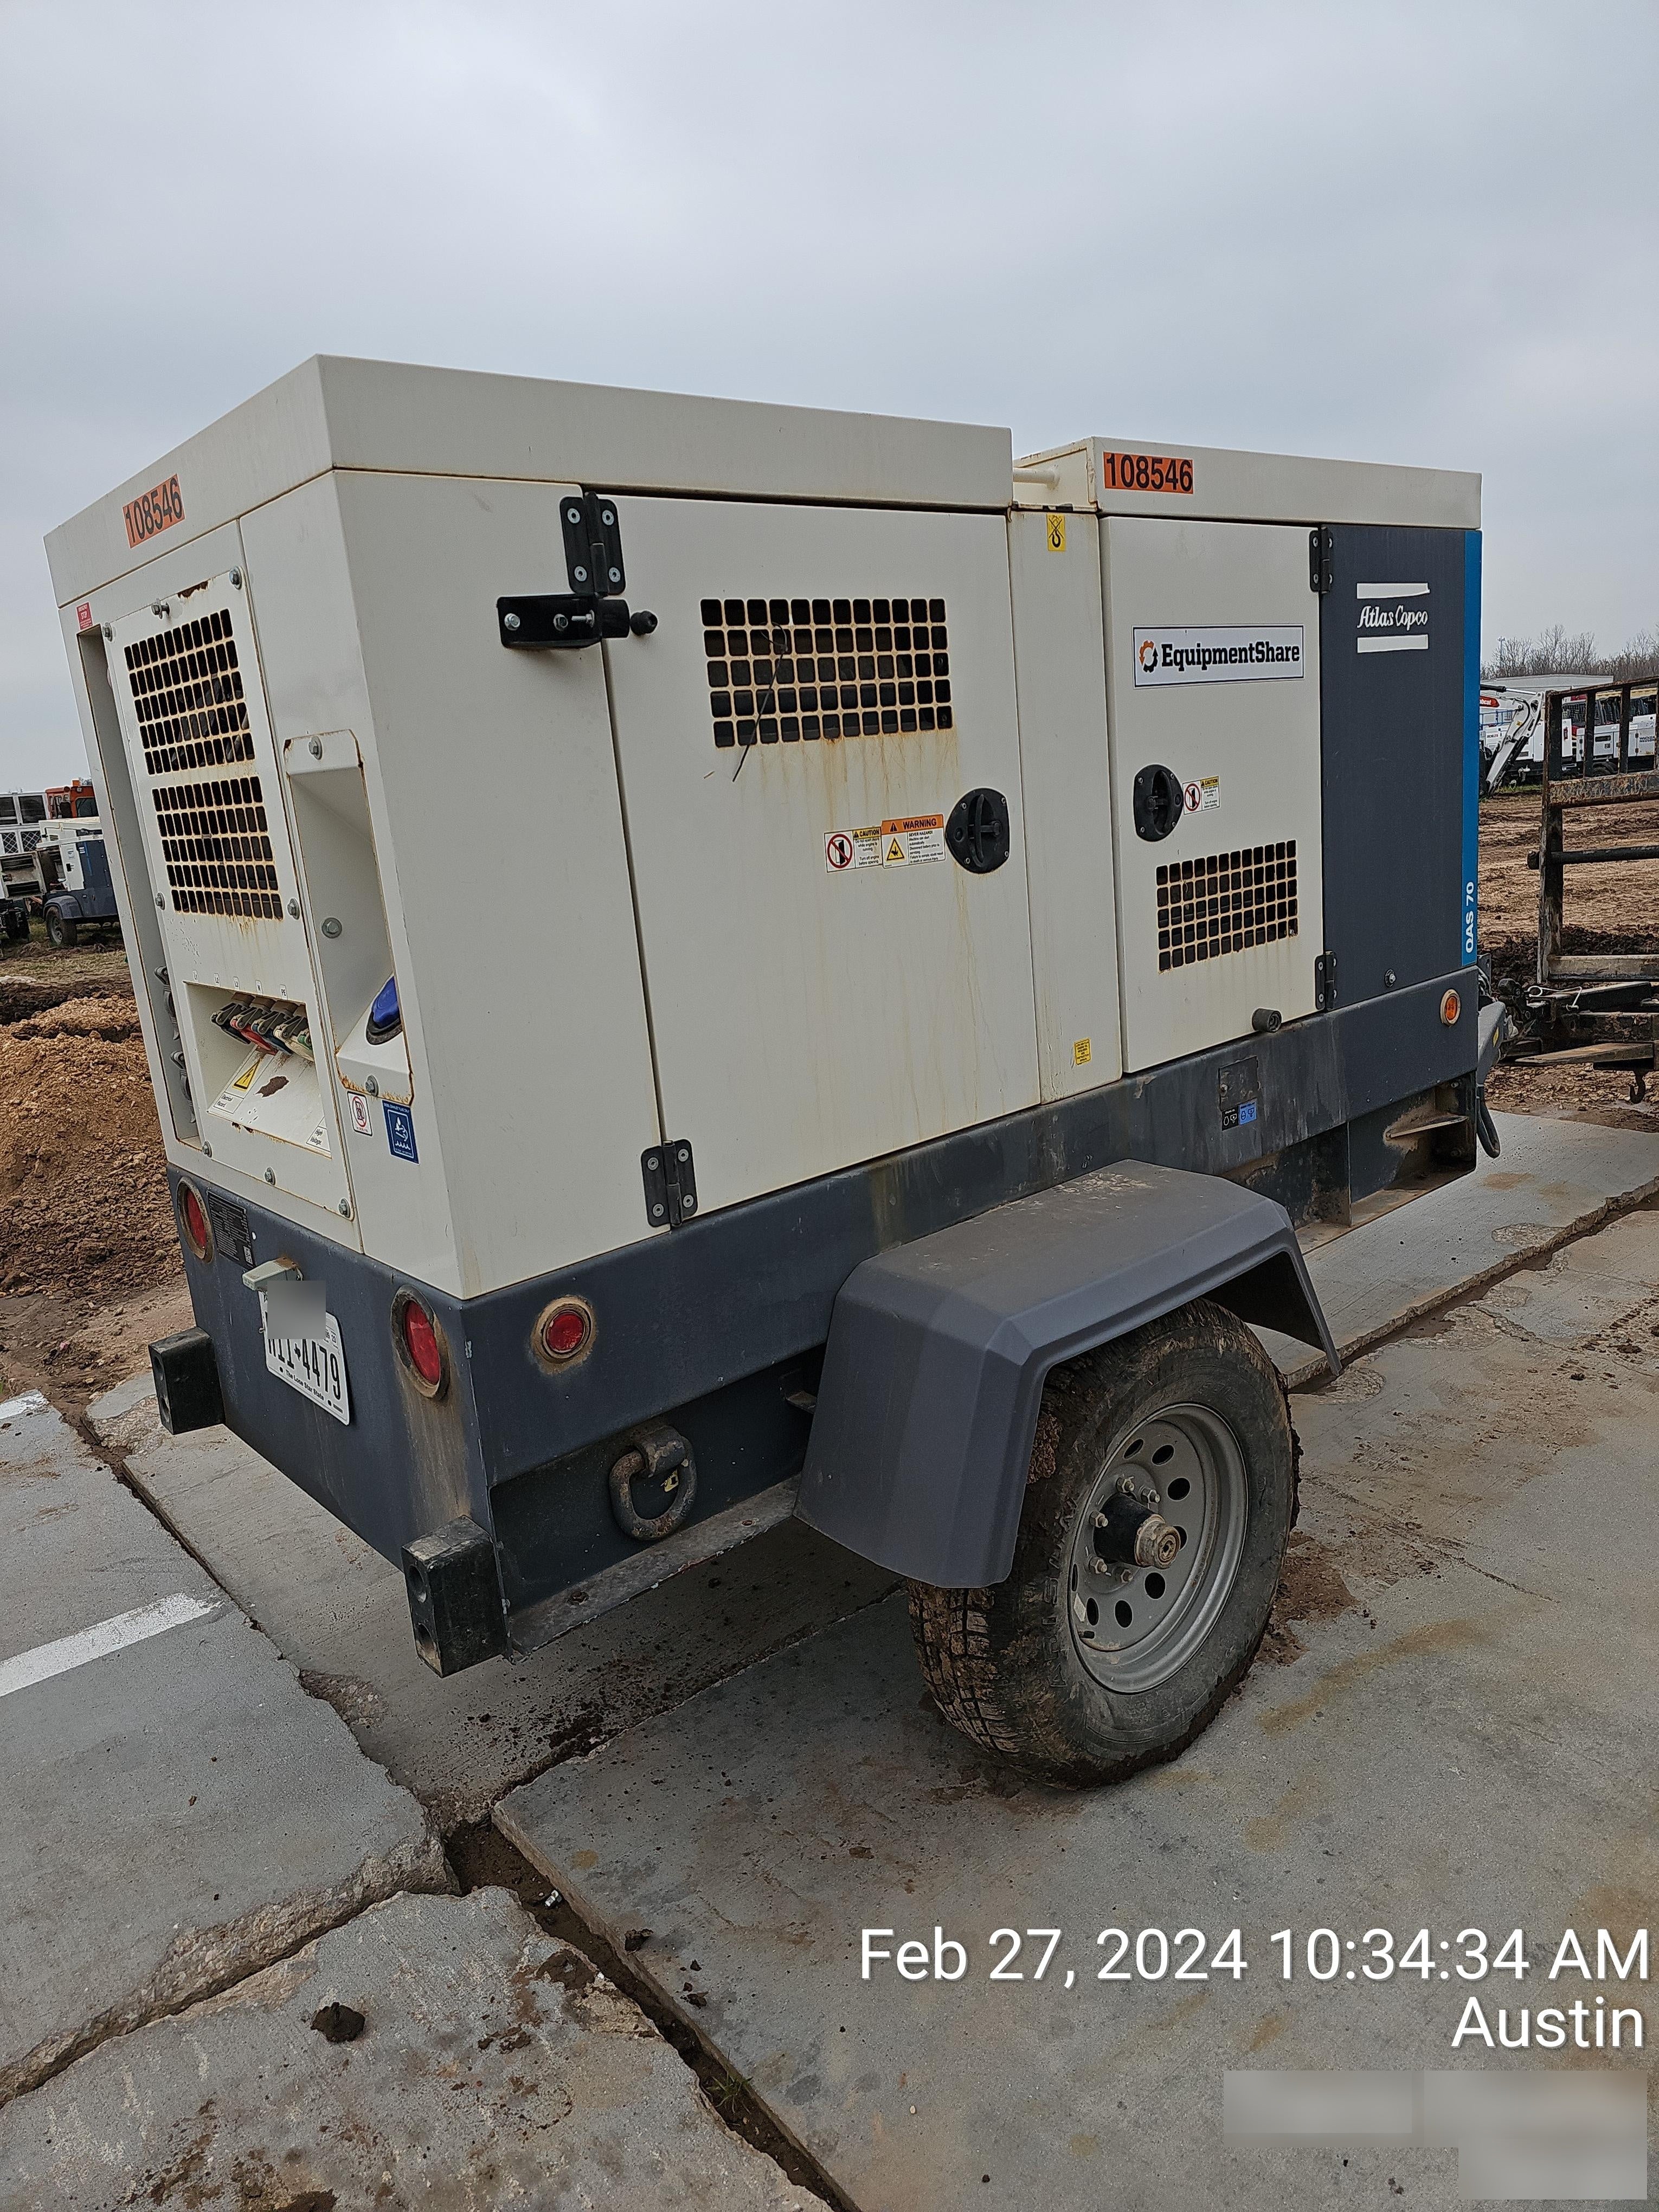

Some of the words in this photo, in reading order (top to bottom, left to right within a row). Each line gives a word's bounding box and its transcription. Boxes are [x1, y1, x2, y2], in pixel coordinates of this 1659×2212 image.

[1107, 453, 1193, 492] 108546
[125, 477, 183, 543] 108546
[1357, 606, 1394, 628] Atlas
[1395, 605, 1428, 631] Copco
[1161, 641, 1300, 671] EquipmentShare
[859, 829, 880, 838] CAUTION
[903, 818, 937, 830] WARNING
[1466, 882, 1474, 906] 70
[285, 1368, 293, 1380] The
[304, 1381, 313, 1393] Star
[302, 1339, 341, 1400] 4479
